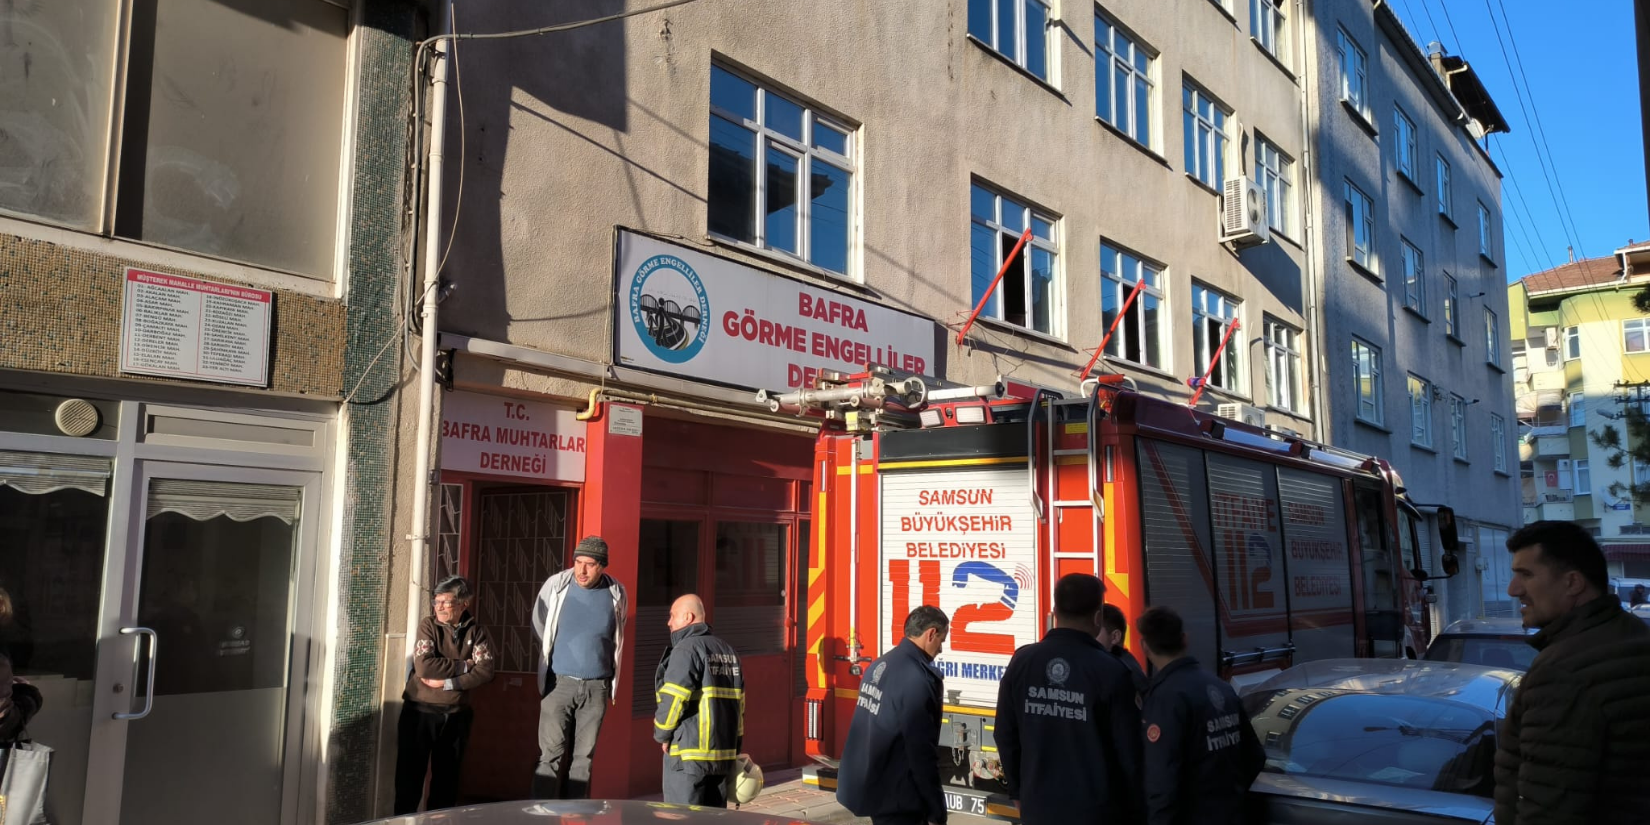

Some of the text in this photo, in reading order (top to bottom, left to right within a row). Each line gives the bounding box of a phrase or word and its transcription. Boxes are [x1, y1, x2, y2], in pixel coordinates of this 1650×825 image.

[136, 275, 167, 284] MÜŞTEREK
[169, 280, 194, 288] MAHALLE
[632, 258, 709, 344] BAFRA GÖRME ENGELLİLER DERNEĞİ
[799, 292, 868, 332] BAFRA
[722, 308, 806, 352] GÖRME
[812, 332, 926, 376] ENGELLİLER
[504, 402, 530, 420] T.C.
[442, 420, 584, 453] BAFRA MUHTARLAR
[480, 452, 546, 474] DERNEĞİ
[919, 488, 993, 506] SAMSUN
[901, 512, 1012, 535] BÜYÜKŞEHİR
[906, 542, 1006, 558] BELEDİYESİ
[1224, 530, 1274, 610] 112
[889, 560, 1018, 655] 112
[962, 662, 1008, 682] MERKE
[1028, 686, 1084, 705] SAMSUN
[1025, 700, 1086, 722] İTFAİYESİ
[971, 798, 984, 814] 75
